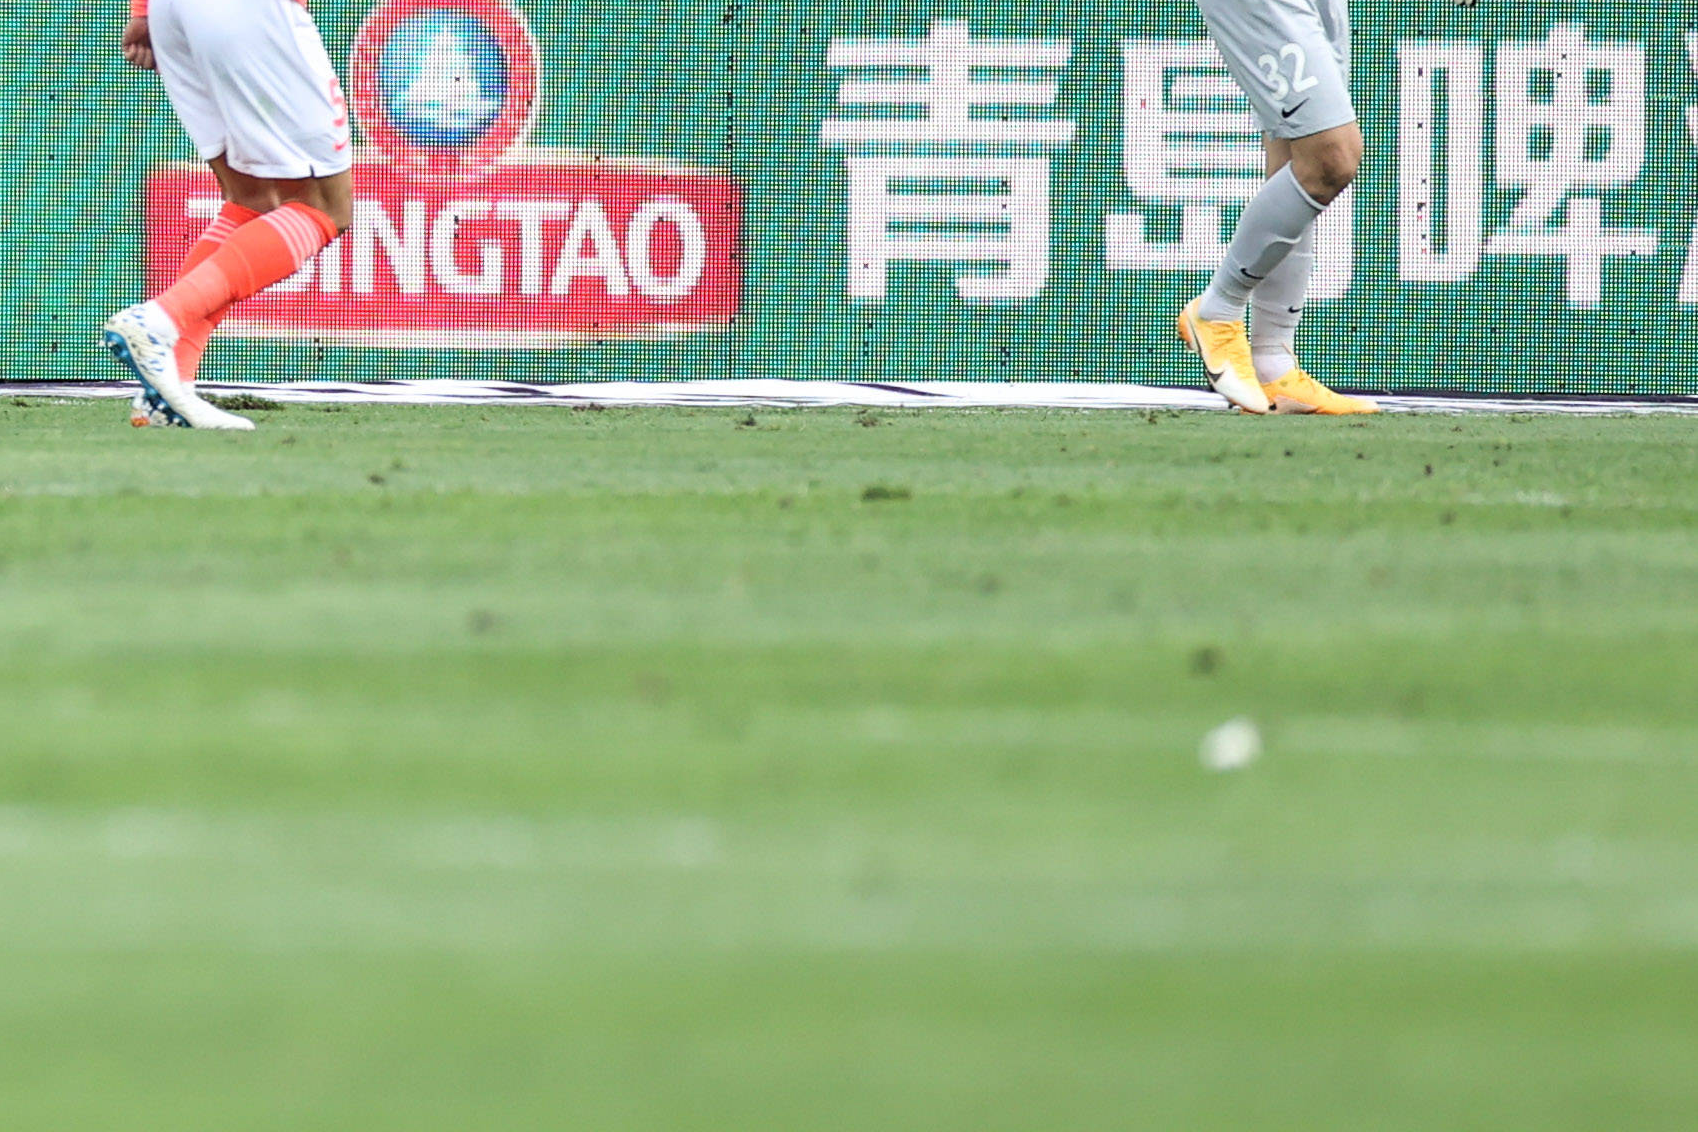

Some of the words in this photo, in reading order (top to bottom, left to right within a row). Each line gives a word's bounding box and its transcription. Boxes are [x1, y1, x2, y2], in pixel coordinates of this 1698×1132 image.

[1257, 42, 1320, 102] 32
[820, 18, 1698, 311] 青岛啤
[186, 194, 706, 305] INGTAO
